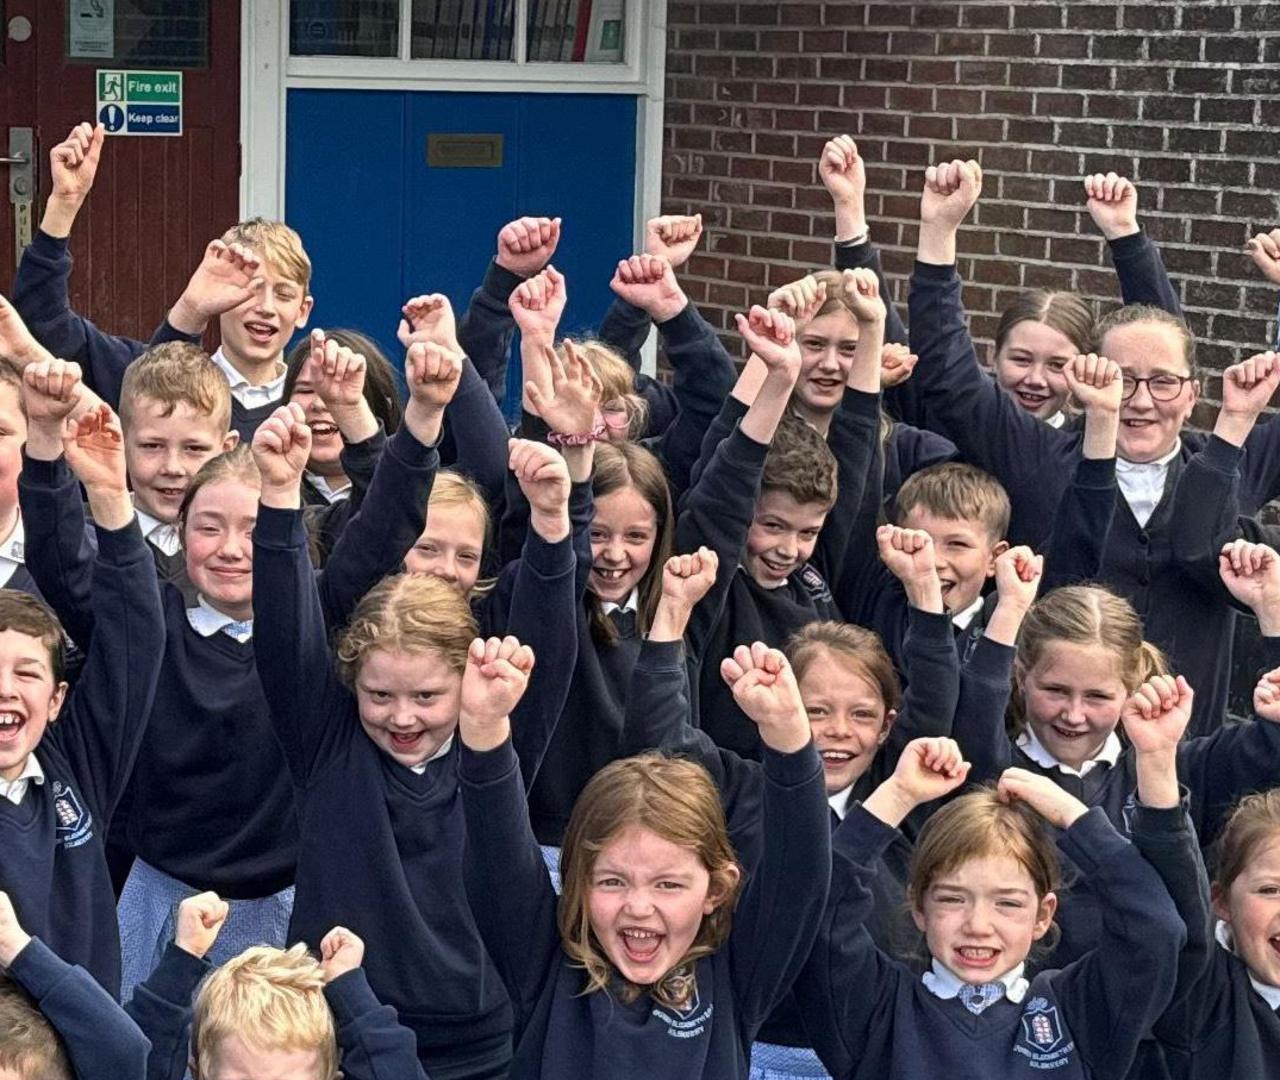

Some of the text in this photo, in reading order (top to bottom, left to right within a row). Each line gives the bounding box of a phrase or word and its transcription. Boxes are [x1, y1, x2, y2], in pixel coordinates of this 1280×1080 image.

[128, 81, 177, 94] Fire exit
[128, 113, 179, 126] Keep clear
